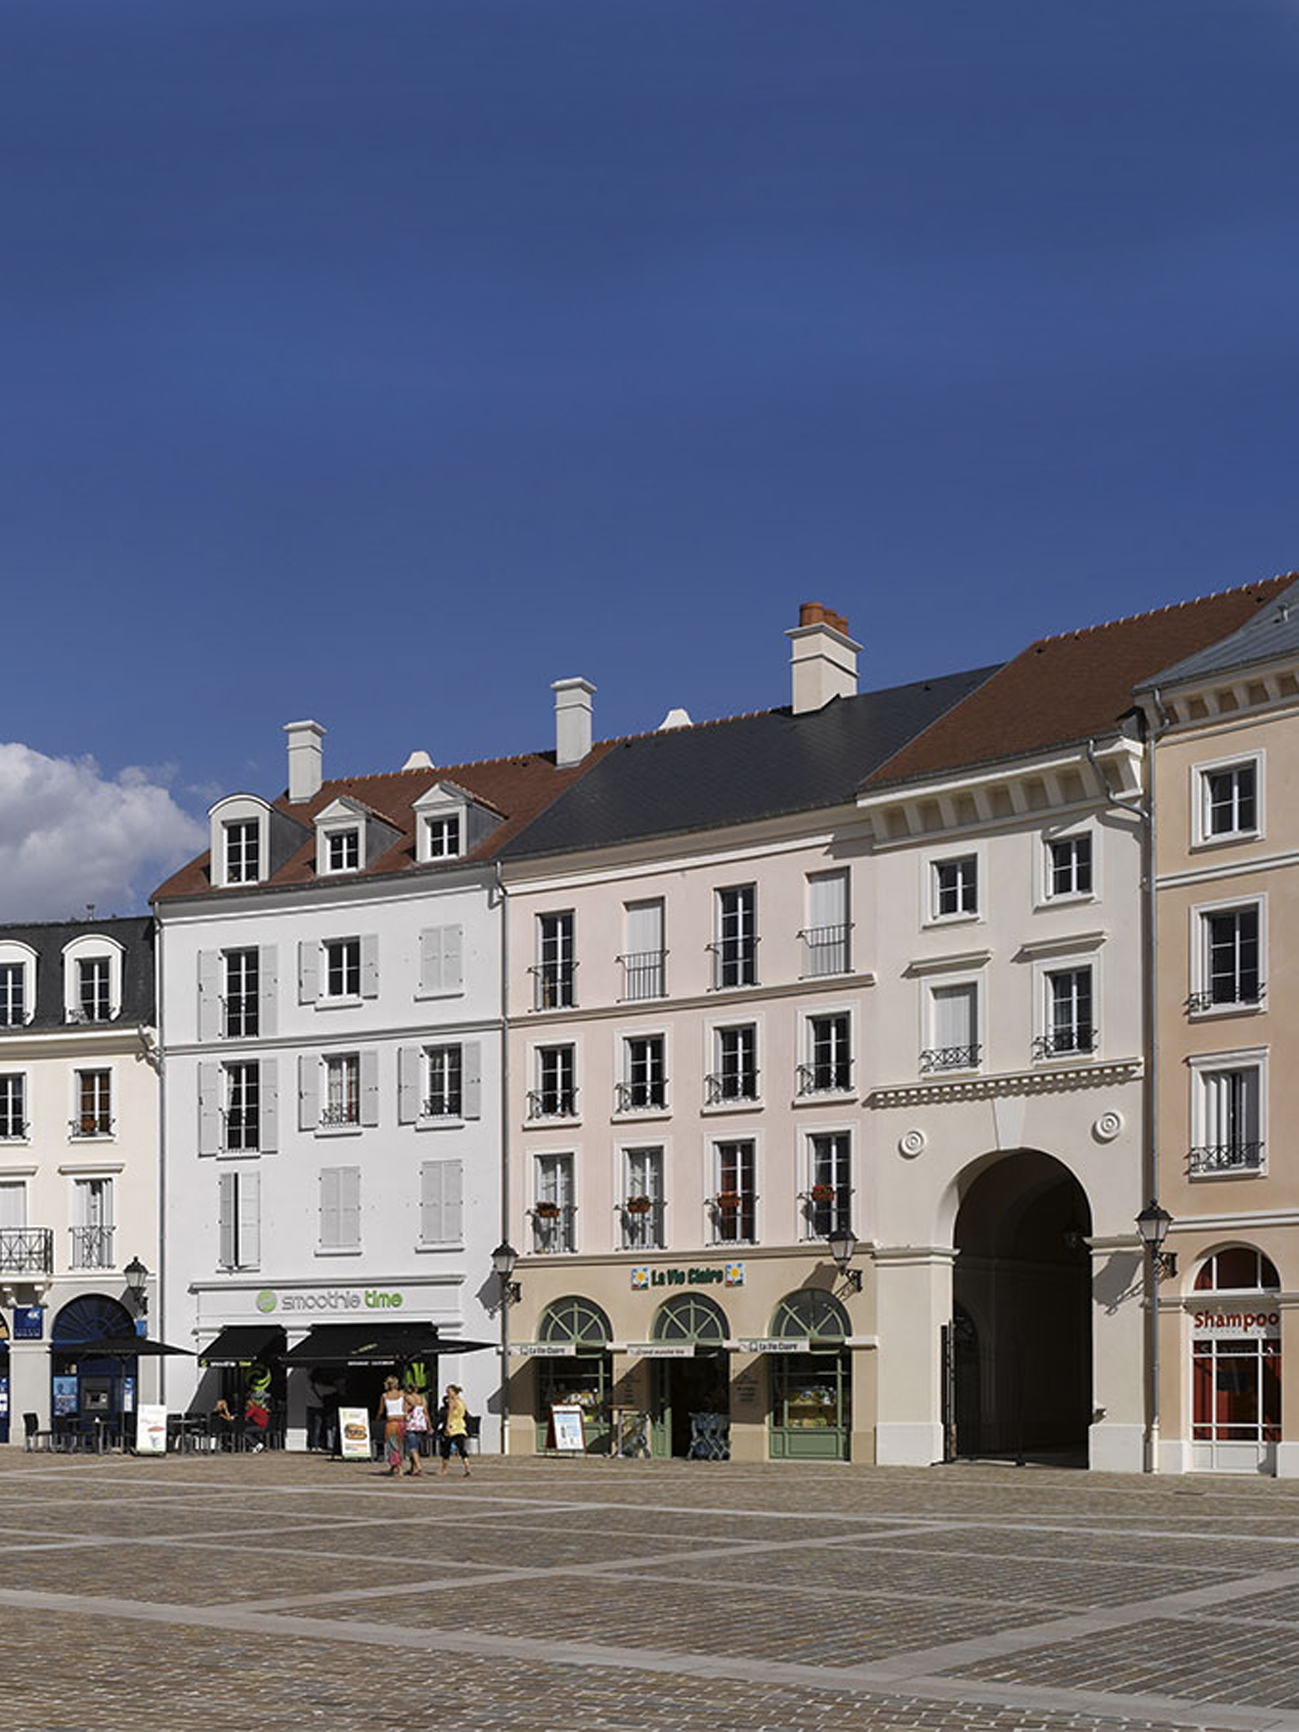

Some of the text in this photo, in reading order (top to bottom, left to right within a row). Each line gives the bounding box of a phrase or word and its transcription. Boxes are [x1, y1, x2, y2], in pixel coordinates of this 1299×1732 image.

[650, 1267, 724, 1286] La Vie Claire
[281, 1288, 403, 1311] smoothie time
[1193, 1310, 1280, 1332] Shampoo
